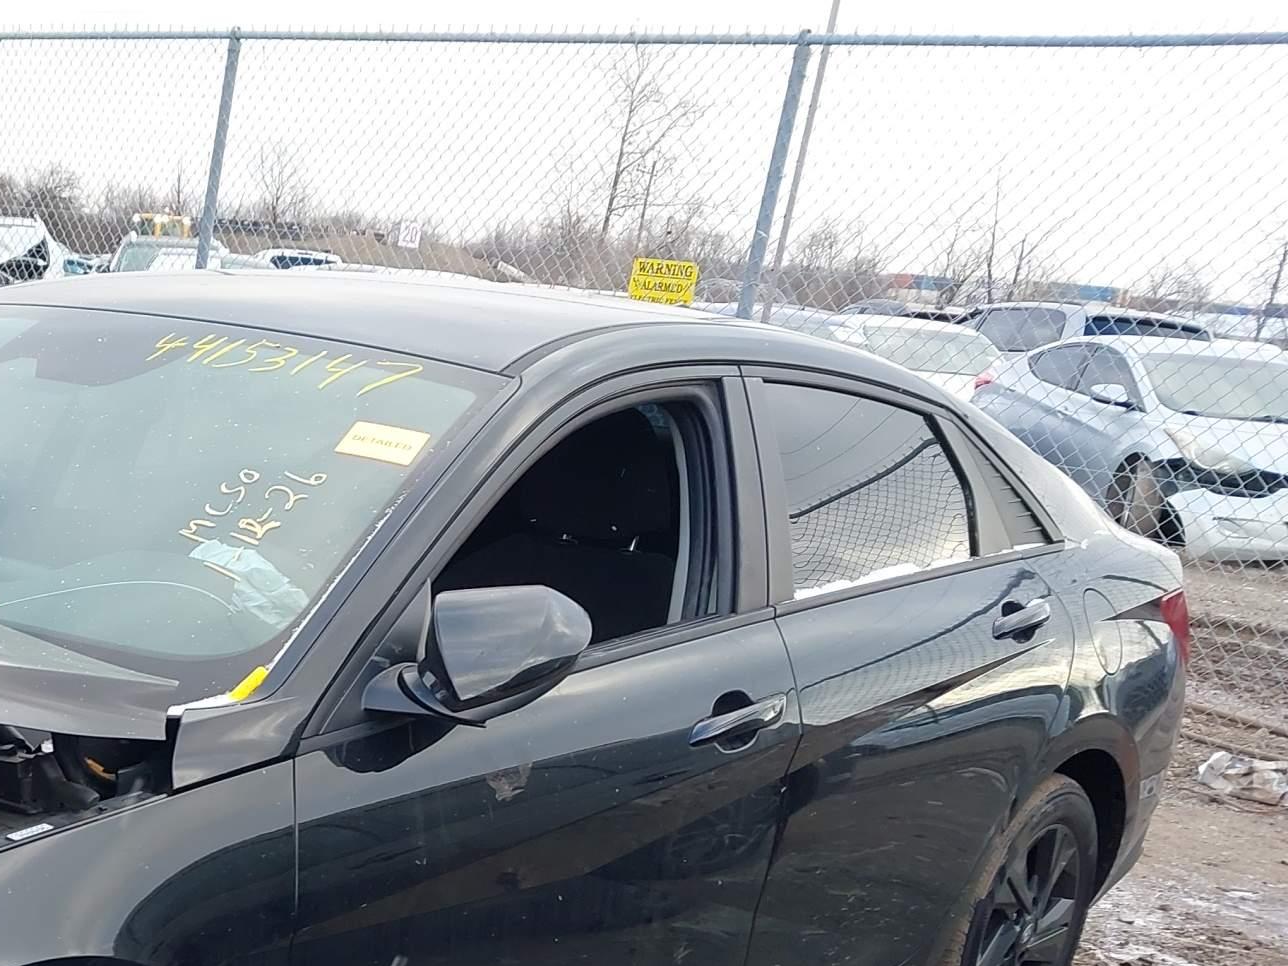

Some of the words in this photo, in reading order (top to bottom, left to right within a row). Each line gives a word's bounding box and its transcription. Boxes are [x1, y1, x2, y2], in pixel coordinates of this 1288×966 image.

[638, 261, 693, 278] WARNING
[640, 280, 683, 293] ALARMED
[146, 333, 423, 397] 44153147
[179, 468, 260, 543] MCSO
